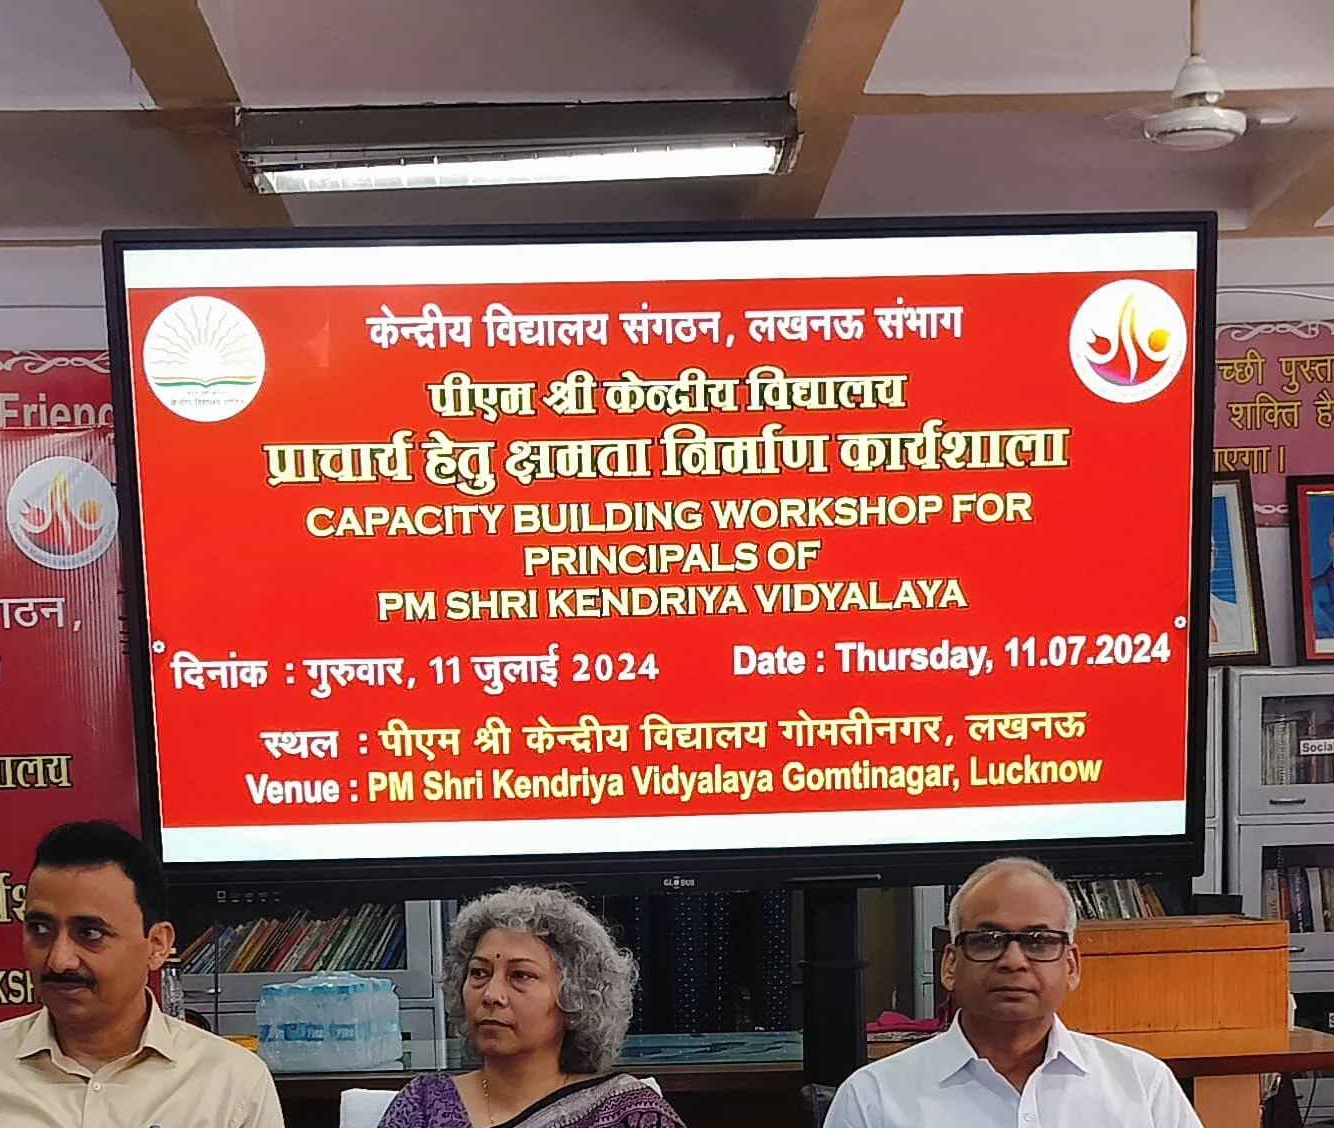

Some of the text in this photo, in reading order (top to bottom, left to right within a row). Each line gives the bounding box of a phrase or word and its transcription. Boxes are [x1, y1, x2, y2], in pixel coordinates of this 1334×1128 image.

[366, 308, 473, 351] केन्द्रीय
[484, 306, 608, 345] विद्यालय
[748, 304, 863, 340] लखनऊ
[875, 296, 964, 337] संभाग
[427, 364, 907, 424] पीएम श्री केन्द्रीय विद्यालय
[1228, 393, 1302, 432] शक्ति
[261, 418, 1071, 495] प्राचार्य हेतु क्षमता निर्माण कार्यशाला
[305, 490, 1033, 540] CAPACITY BUILDING WORKSHOP FOR
[523, 540, 821, 577] PRINCIPALS OF
[377, 576, 969, 624] PM SHRI KENDRIYA VIDYALAYA
[170, 650, 268, 691] दिनांक
[303, 648, 419, 698] गुरुवार,
[433, 652, 462, 685] 11
[471, 641, 559, 694] जुलाई
[571, 650, 660, 680] 2024
[732, 643, 805, 676] Date
[834, 636, 993, 677] Thursday,
[1005, 632, 1172, 668] 11.07.2024
[260, 725, 340, 761] स्थल
[378, 715, 462, 766] पीएम
[473, 713, 516, 754] श्री
[524, 711, 629, 761] केन्द्रीय
[639, 710, 768, 751] विद्यालय
[780, 706, 952, 749] गोमतीनगर,
[966, 708, 1088, 742] लखनऊ
[246, 773, 342, 808] Venue
[367, 770, 418, 801] PM
[424, 766, 485, 799] Shri
[492, 763, 626, 801] Kendriya
[632, 760, 775, 797] Vidyalaya
[781, 756, 961, 792] Gomtinagar,
[969, 751, 1102, 785] Lucknow
